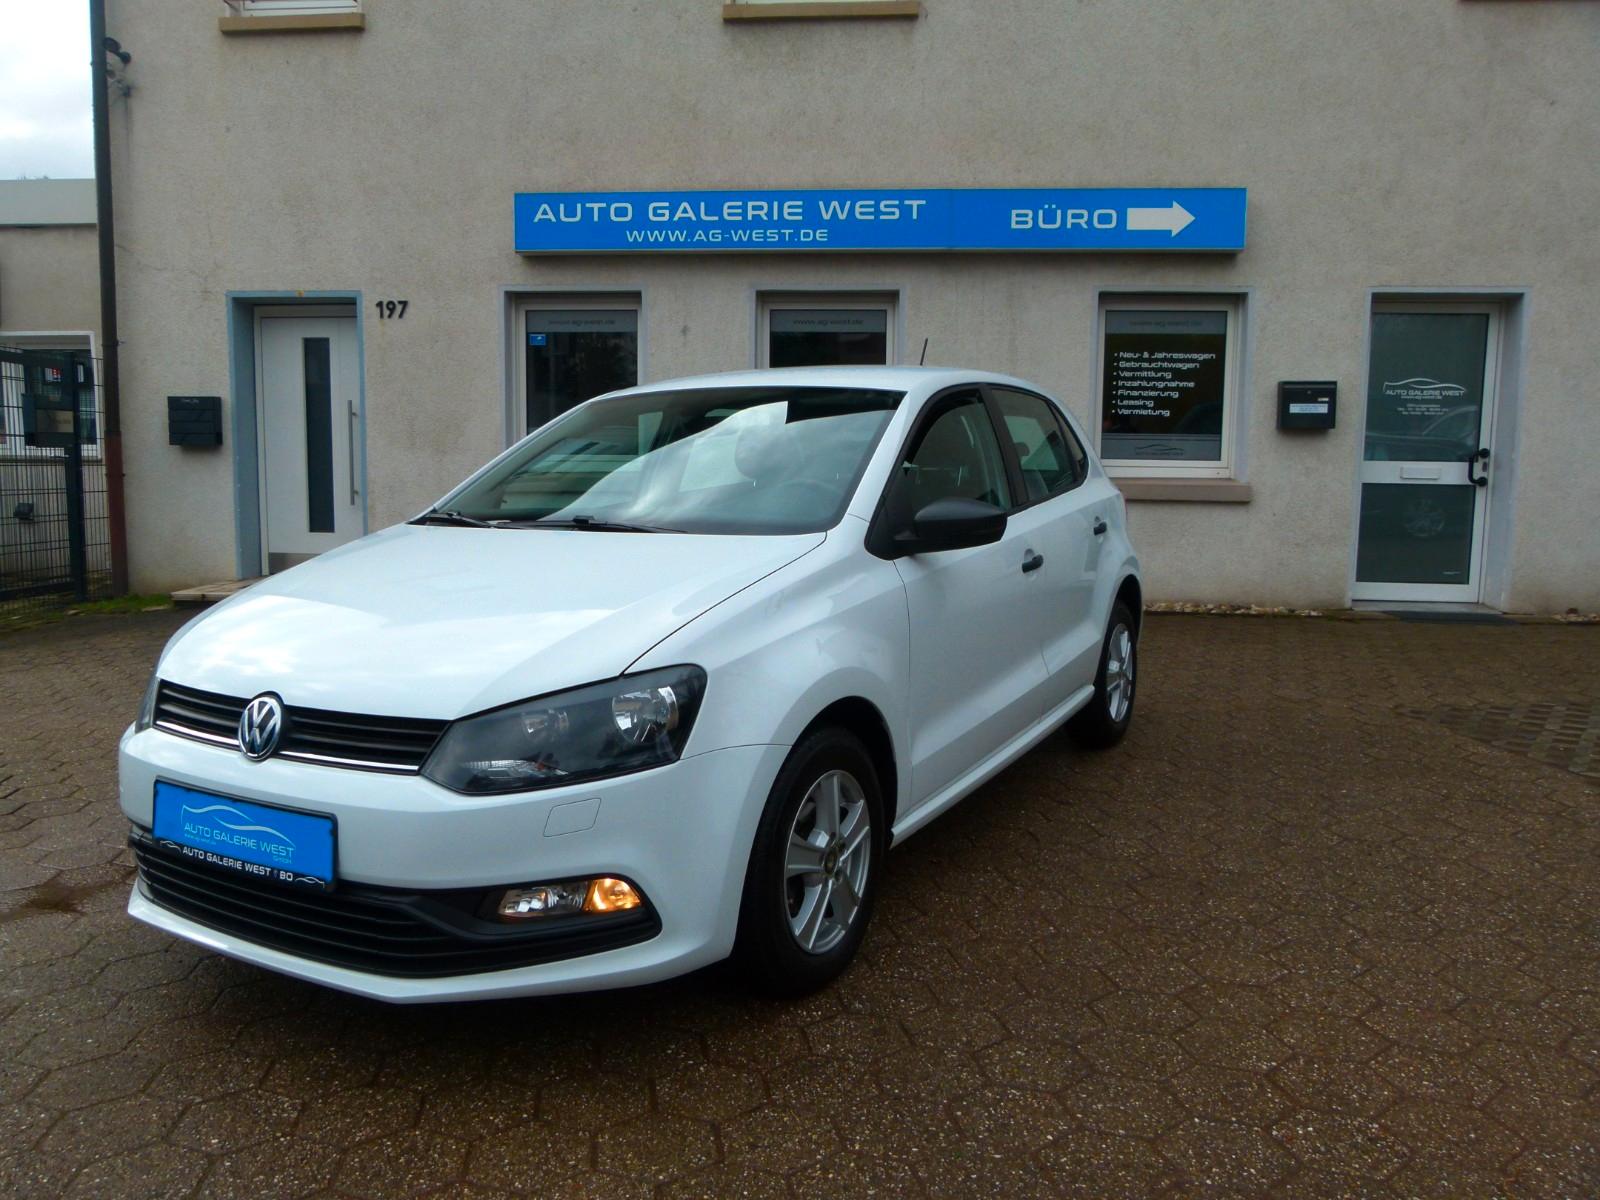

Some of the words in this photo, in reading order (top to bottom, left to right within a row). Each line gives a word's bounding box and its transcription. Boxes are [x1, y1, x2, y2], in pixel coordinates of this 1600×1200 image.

[534, 203, 633, 222] AUTO
[648, 201, 803, 221] GALERIE
[819, 200, 926, 220] WEST
[1011, 204, 1117, 229] BÜRO
[626, 229, 828, 242] WWW.AG-WEST.DE
[375, 300, 409, 319] 197
[1119, 351, 1142, 359] Neu-
[1142, 351, 1150, 359] &
[1151, 352, 1216, 360] Jahreswagen
[1118, 361, 1200, 370] Gebrauchtwagen
[1118, 370, 1172, 379] Vermittlung
[1118, 380, 1195, 388] Inzahlungnahme
[1117, 390, 1179, 398] Finanzierung
[1117, 399, 1154, 407] Leasing
[1117, 408, 1170, 417] Vermietung
[184, 822, 211, 838] AUTO
[213, 830, 257, 850] GALERIE
[260, 841, 294, 857] WEST
[183, 846, 205, 860] AUTO
[206, 853, 242, 870] GALERIE
[245, 863, 272, 876] WEST
